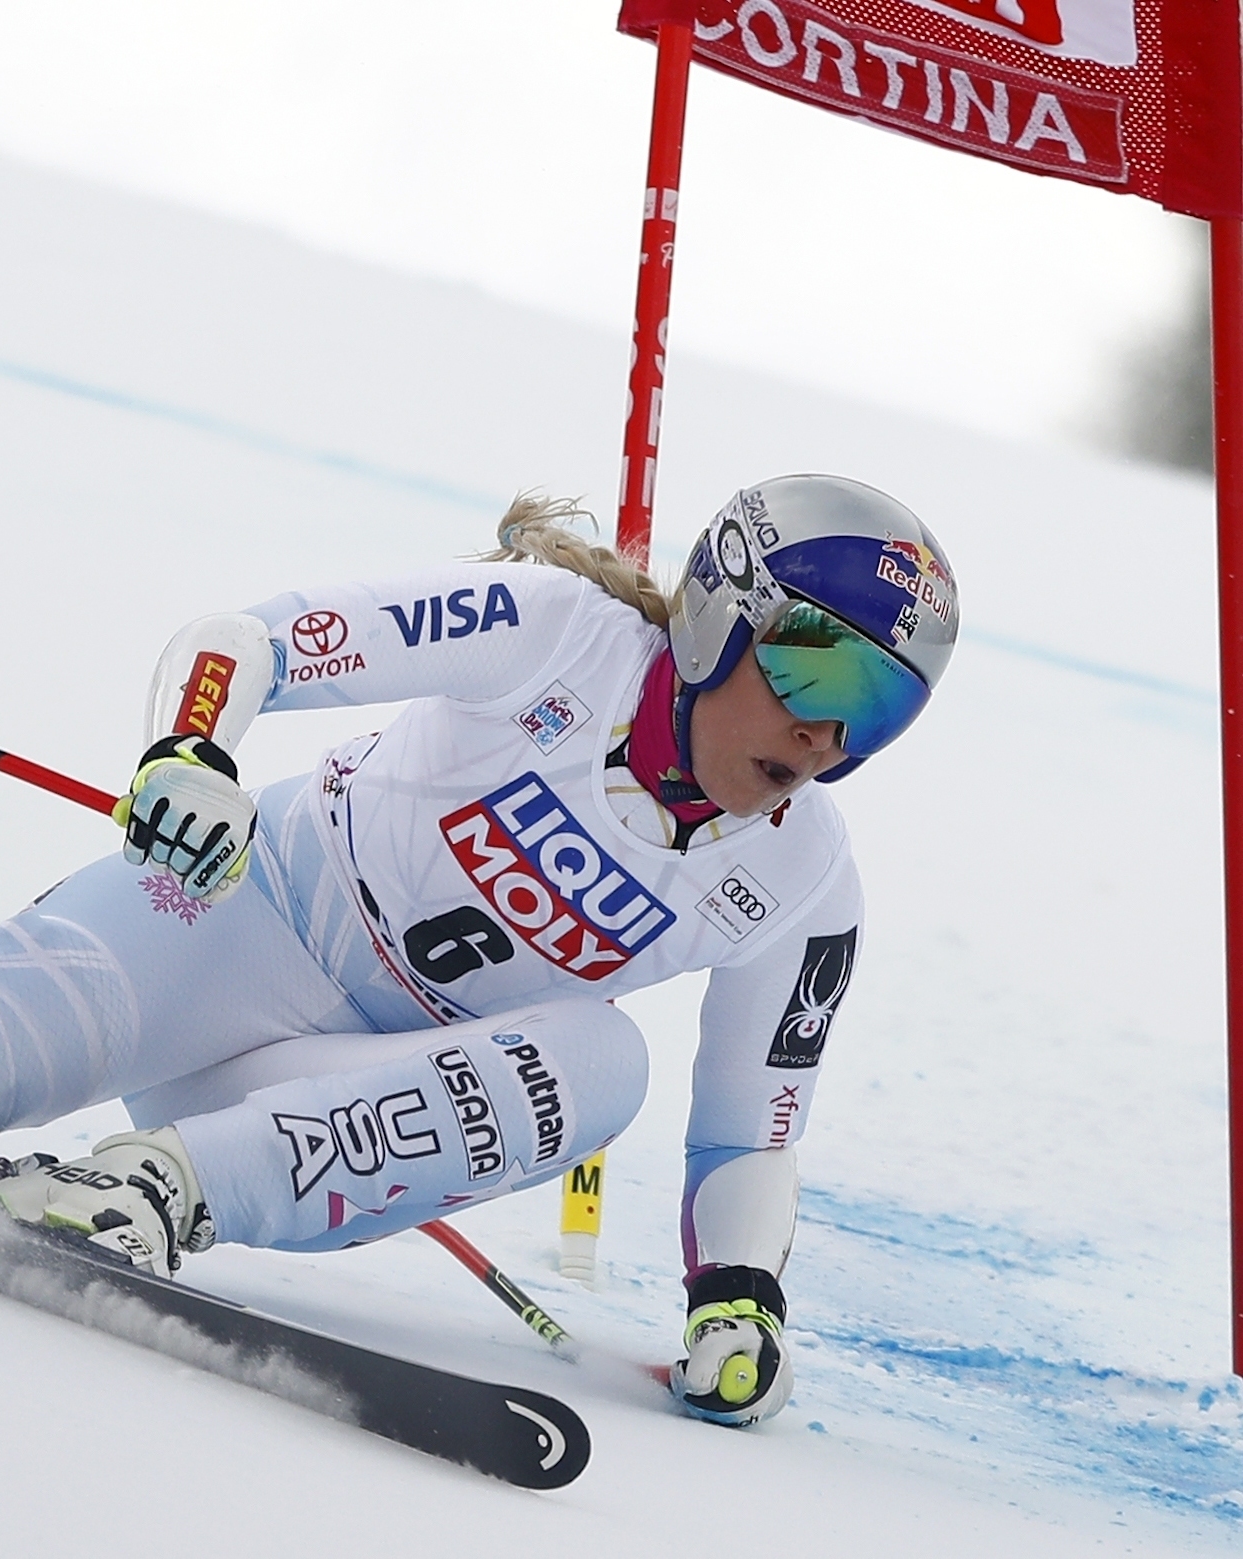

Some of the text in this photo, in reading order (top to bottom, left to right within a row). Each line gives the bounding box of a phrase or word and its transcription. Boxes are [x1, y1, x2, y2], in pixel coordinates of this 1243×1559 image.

[378, 583, 519, 647] VISA
[879, 556, 951, 623] Red Bull
[188, 659, 228, 734] LEKI
[289, 652, 366, 684] TOYOTA
[193, 839, 236, 889] reusch
[446, 812, 626, 972] MOLY
[492, 781, 667, 949] LIQUI
[402, 905, 515, 985] 6
[271, 1087, 442, 1203] USA
[435, 1049, 502, 1179] USANA
[769, 1084, 800, 1147] xfini
[44, 1164, 123, 1190] HEAD
[571, 1163, 600, 1197] M
